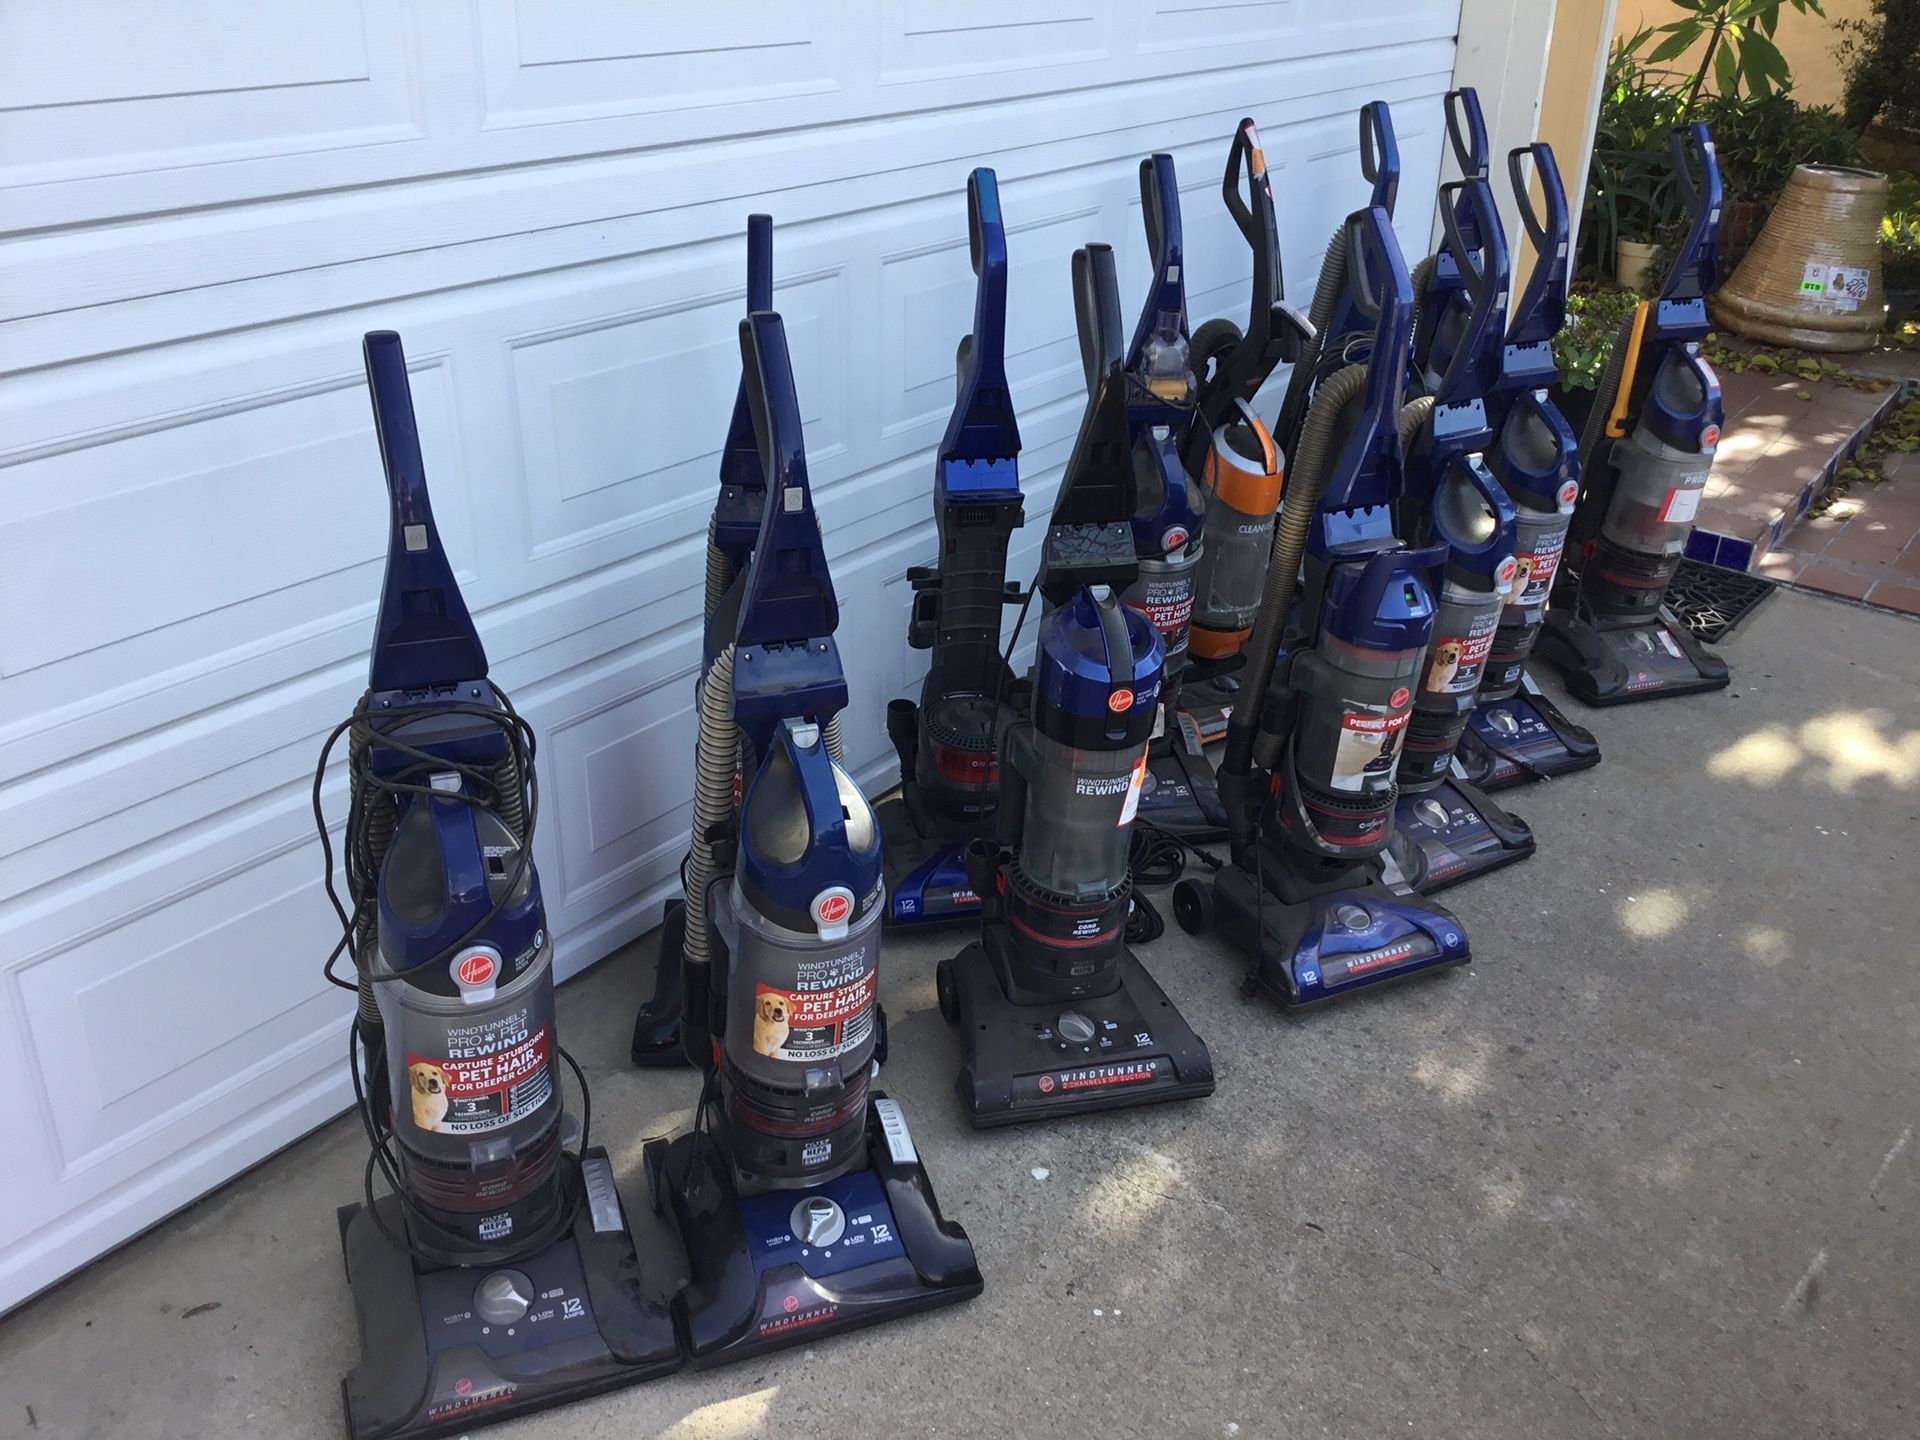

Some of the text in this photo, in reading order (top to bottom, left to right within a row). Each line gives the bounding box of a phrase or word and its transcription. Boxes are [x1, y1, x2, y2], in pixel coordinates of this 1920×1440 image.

[1146, 592, 1188, 604] REWIND
[1147, 588, 1166, 597] PRO
[1154, 612, 1173, 621] PET
[1468, 644, 1484, 654] PET
[1076, 782, 1128, 796] REWIND
[900, 900, 915, 910] 12
[798, 952, 859, 970] WINDTUNNEL
[1346, 945, 1408, 968] WINDTUNNEL
[797, 955, 864, 981] PRO PET
[1302, 970, 1317, 982] 12
[796, 966, 864, 991] REWIND
[790, 991, 834, 1002] CAPTURE
[803, 986, 867, 1012] PET HAIR
[794, 990, 872, 1021] FOR DEEPER CLEAN
[447, 1008, 527, 1036] WINDTUNNEL 3
[448, 1017, 528, 1048] PRO PET
[805, 1032, 814, 1040] 3
[1134, 1032, 1150, 1043] 12
[442, 1028, 544, 1070] CAPTURE STUBBORN
[448, 1028, 528, 1058] REWIND
[788, 1050, 802, 1058] NO
[804, 1049, 828, 1058] LOSS
[842, 1026, 871, 1049] SUCTION
[452, 1052, 543, 1092] FOR DEEPER CLEAN
[460, 1048, 534, 1082] PET HAIR
[1060, 1064, 1152, 1082] WINDTUNNEL
[1070, 1078, 1107, 1087] CHANNELS
[1120, 1072, 1151, 1080] SUCTION
[467, 1102, 476, 1112] 3
[470, 1119, 496, 1130] LOSS
[498, 1114, 511, 1124] OF
[514, 1090, 549, 1118] SUCTION
[870, 1224, 890, 1238] 12
[874, 1236, 893, 1245] AMPS
[561, 1298, 582, 1314] 12
[563, 1310, 585, 1320] AMPS
[760, 1307, 834, 1330] WINDTUNNEL
